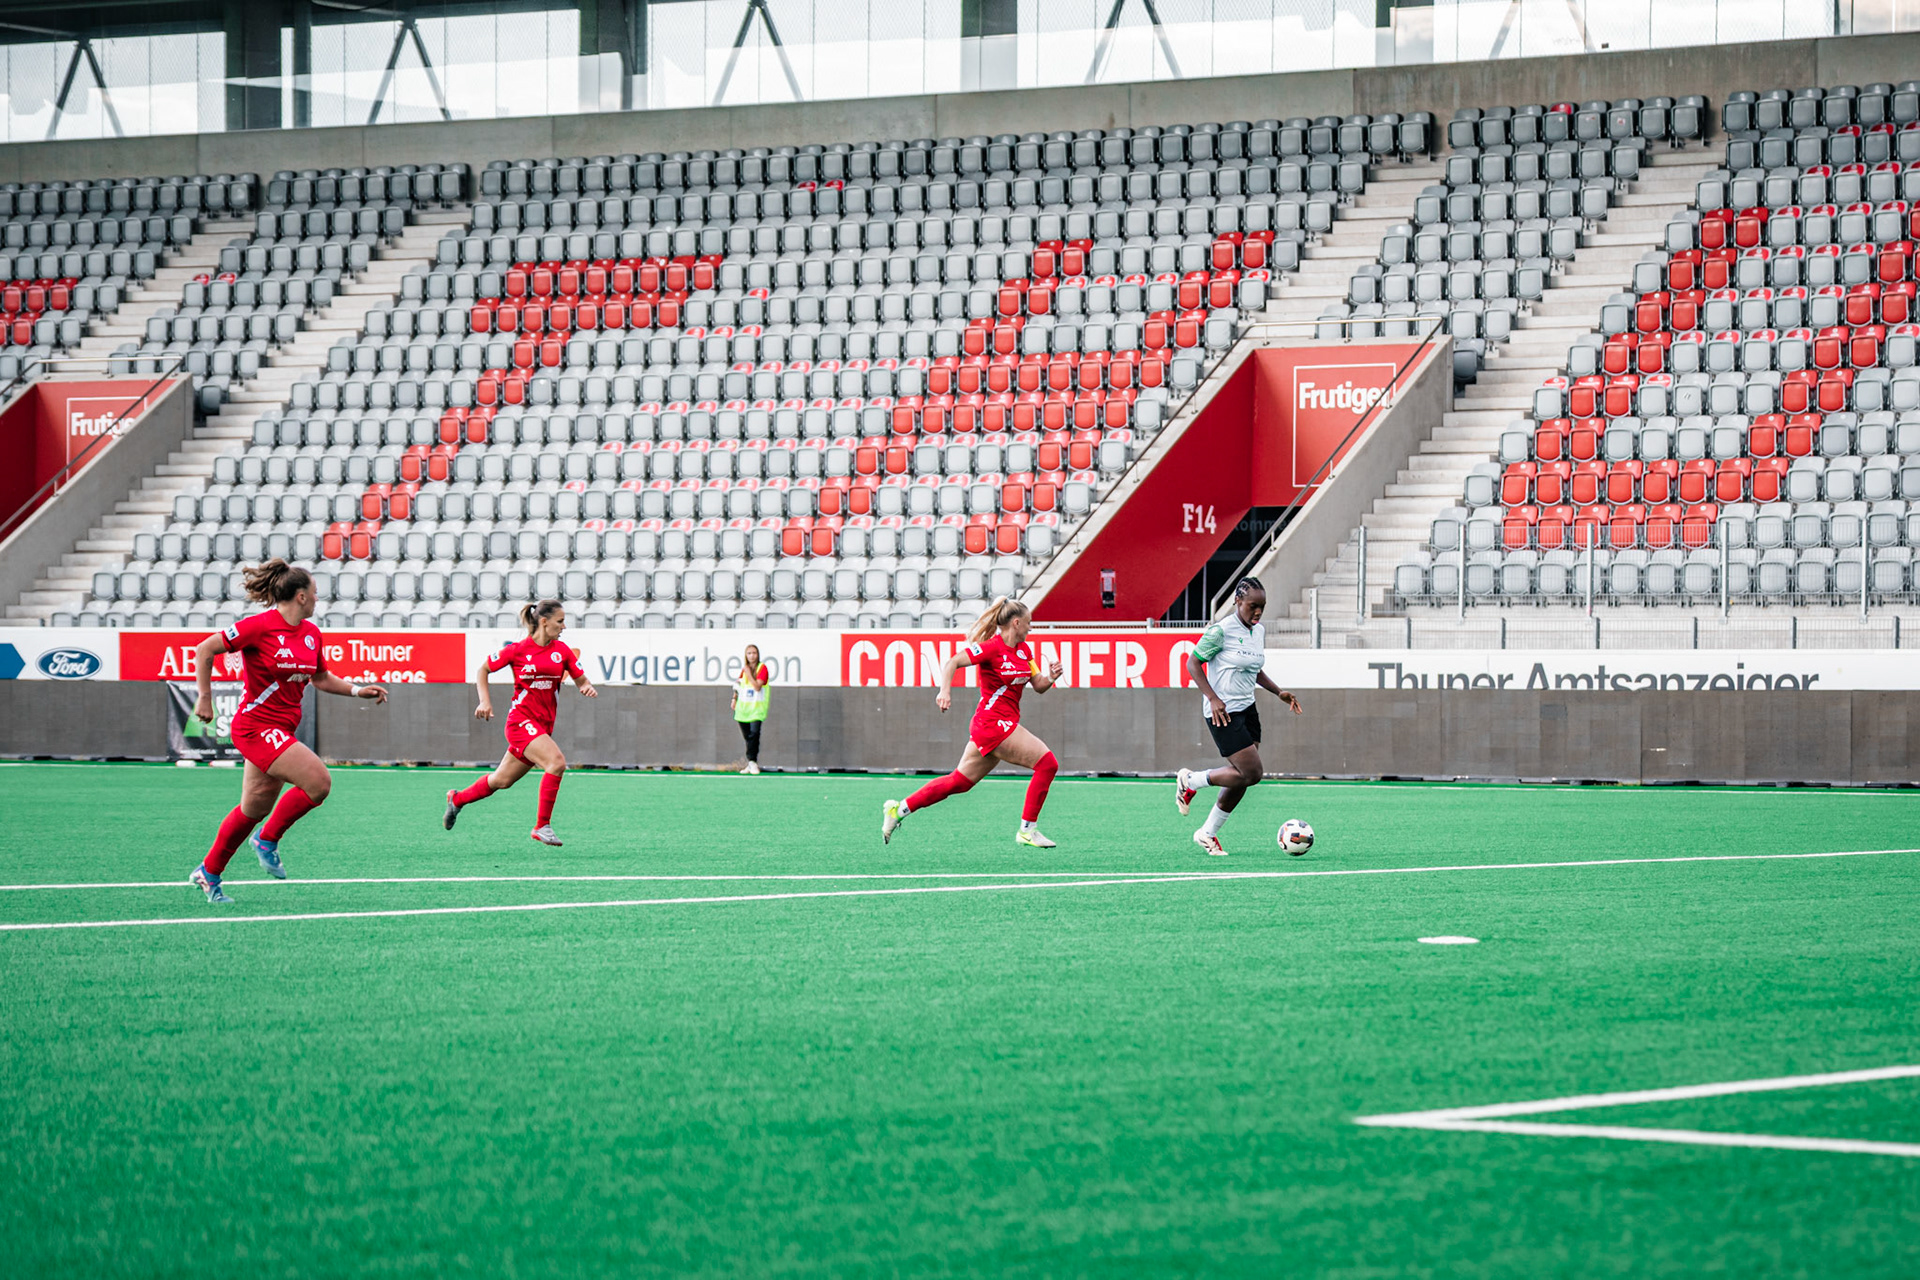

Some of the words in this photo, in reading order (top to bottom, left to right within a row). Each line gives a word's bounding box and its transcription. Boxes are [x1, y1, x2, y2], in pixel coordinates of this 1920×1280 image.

[71, 411, 137, 440] Frutige
[1182, 503, 1217, 534] F14
[48, 651, 92, 675] Ford
[347, 639, 414, 662] Thuner
[598, 655, 696, 684] vigier
[703, 646, 802, 682] beon
[1368, 662, 1514, 690] Thuner
[1526, 662, 1820, 691] Amtsanzeiger
[265, 728, 290, 750] 22
[525, 723, 538, 736] 8
